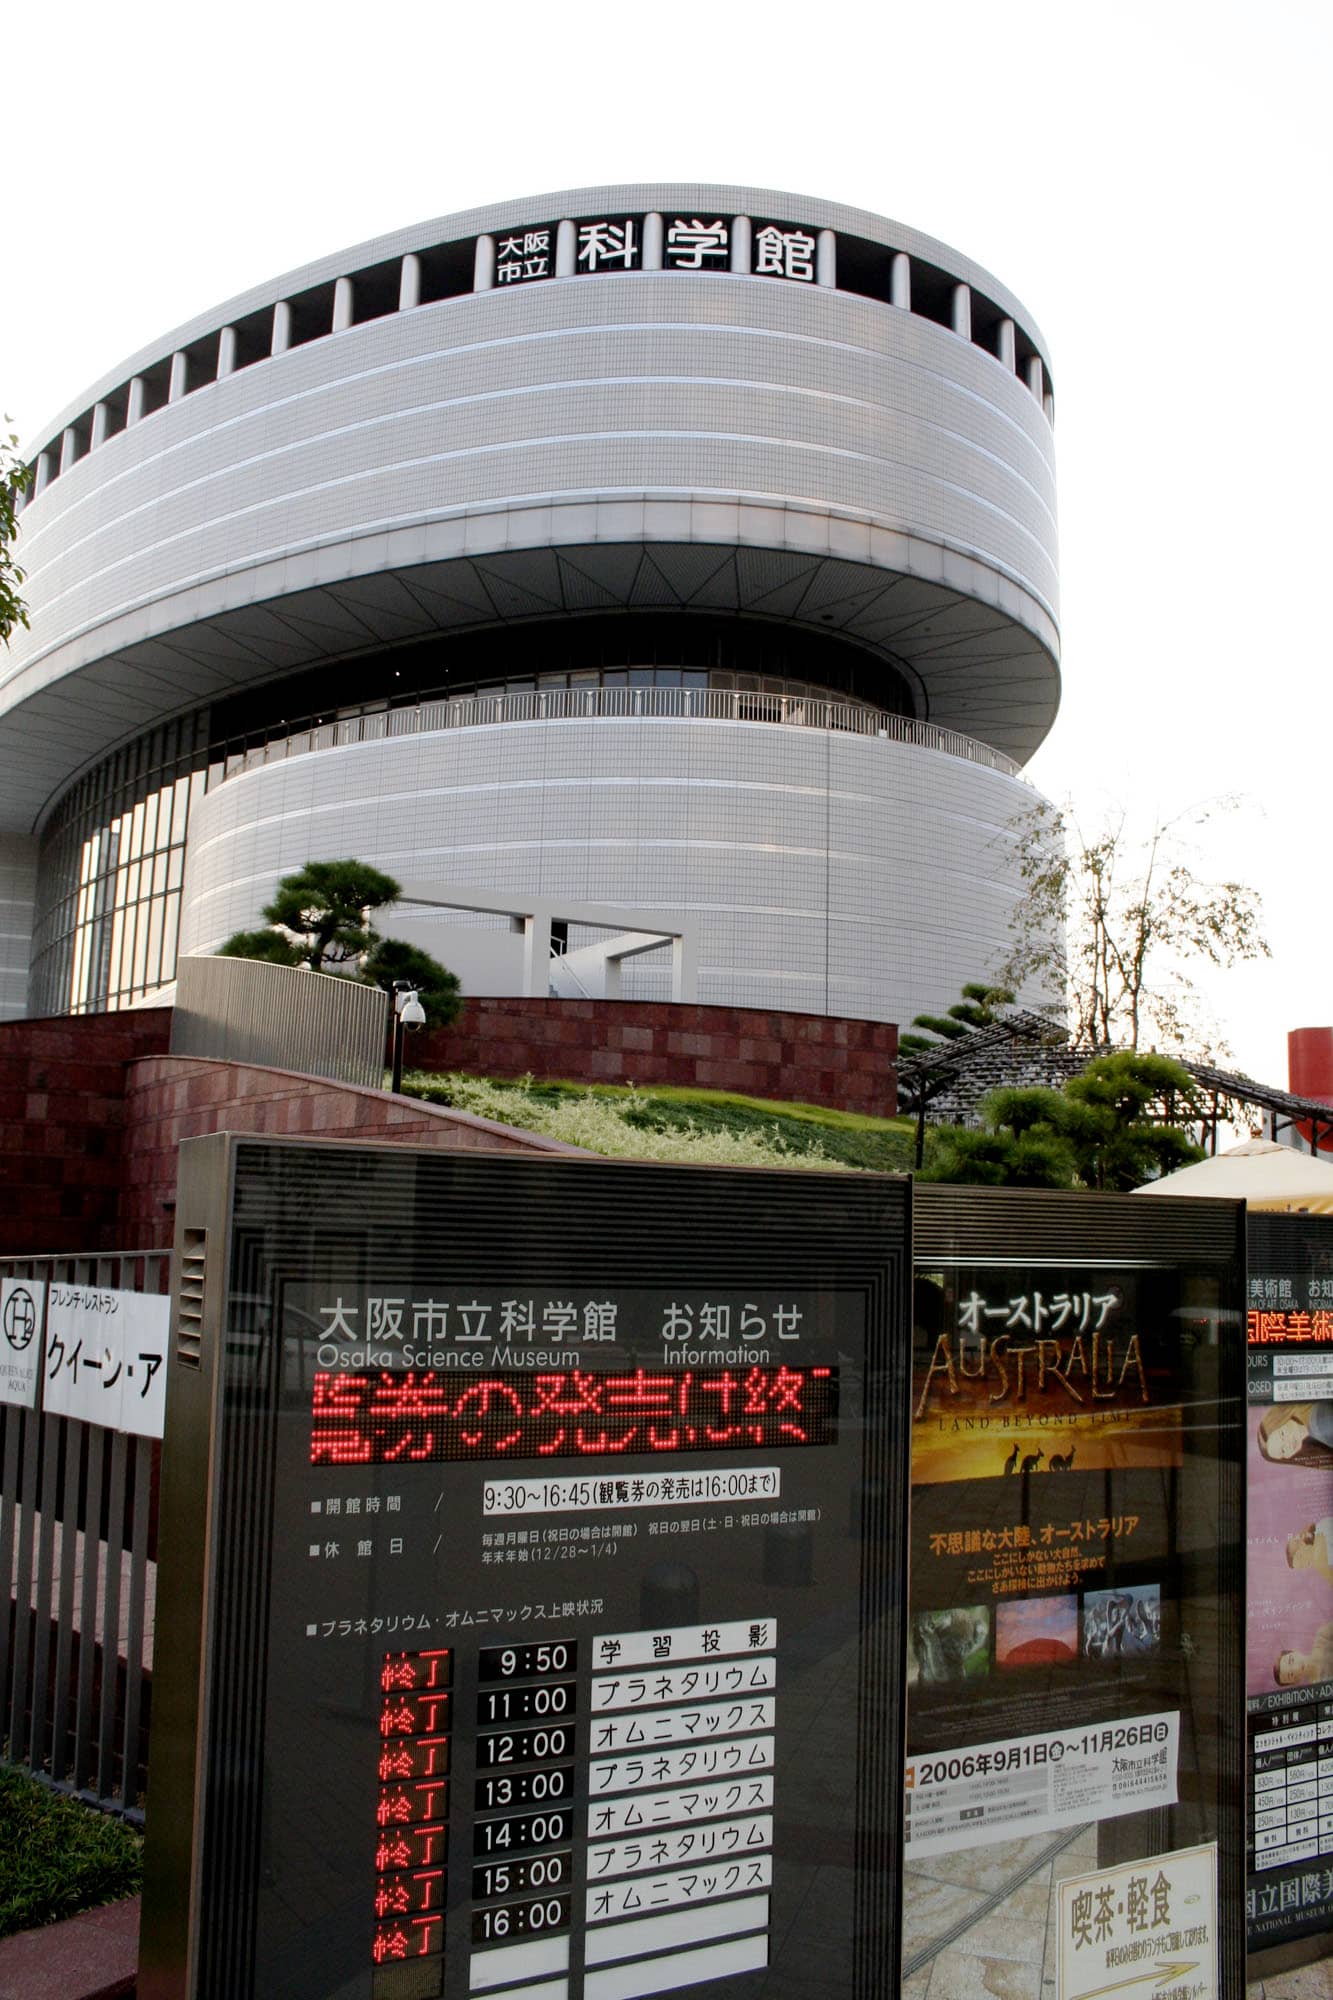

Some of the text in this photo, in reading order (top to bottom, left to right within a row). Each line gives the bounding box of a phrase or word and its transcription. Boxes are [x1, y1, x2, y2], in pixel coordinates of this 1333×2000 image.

[498, 229, 550, 259] 大阪
[578, 218, 816, 281] 科学館
[498, 256, 549, 283] 市立
[51, 1289, 119, 1315] フレンチ・レストラン
[1247, 1279, 1292, 1298] 美術館
[317, 1297, 804, 1343] 大阪市立科学館 お知らせ
[958, 1291, 1118, 1334] オーストラリア
[317, 1343, 770, 1368] Osaka Science Museum Information
[915, 1332, 1148, 1422] AUSTRALIA
[939, 1416, 989, 1431] LAND
[1003, 1413, 1078, 1428] BEYOND
[326, 1496, 401, 1515] 開館時間
[324, 1537, 404, 1558] 休館日
[930, 1516, 1139, 1556] 不思議な大陸、オーストラリア
[500, 1624, 768, 1676] 9:50 学習投影
[488, 1664, 768, 1720] 11:00 プラネタリウム
[1268, 1688, 1314, 1708] EXHIBITION
[487, 1703, 767, 1763] 12:00 オムニマックス
[486, 1744, 767, 1805] 13:00 プラネタリウム
[1112, 1747, 1168, 1774] 大阪市立科学館
[485, 1782, 765, 1850] 14:00 オムニマックス
[484, 1824, 765, 1894] 15:00 プラネタリウム
[483, 1862, 763, 1937] 16:00 オムニマックス
[1071, 1870, 1171, 1950] 喫茶・軽食
